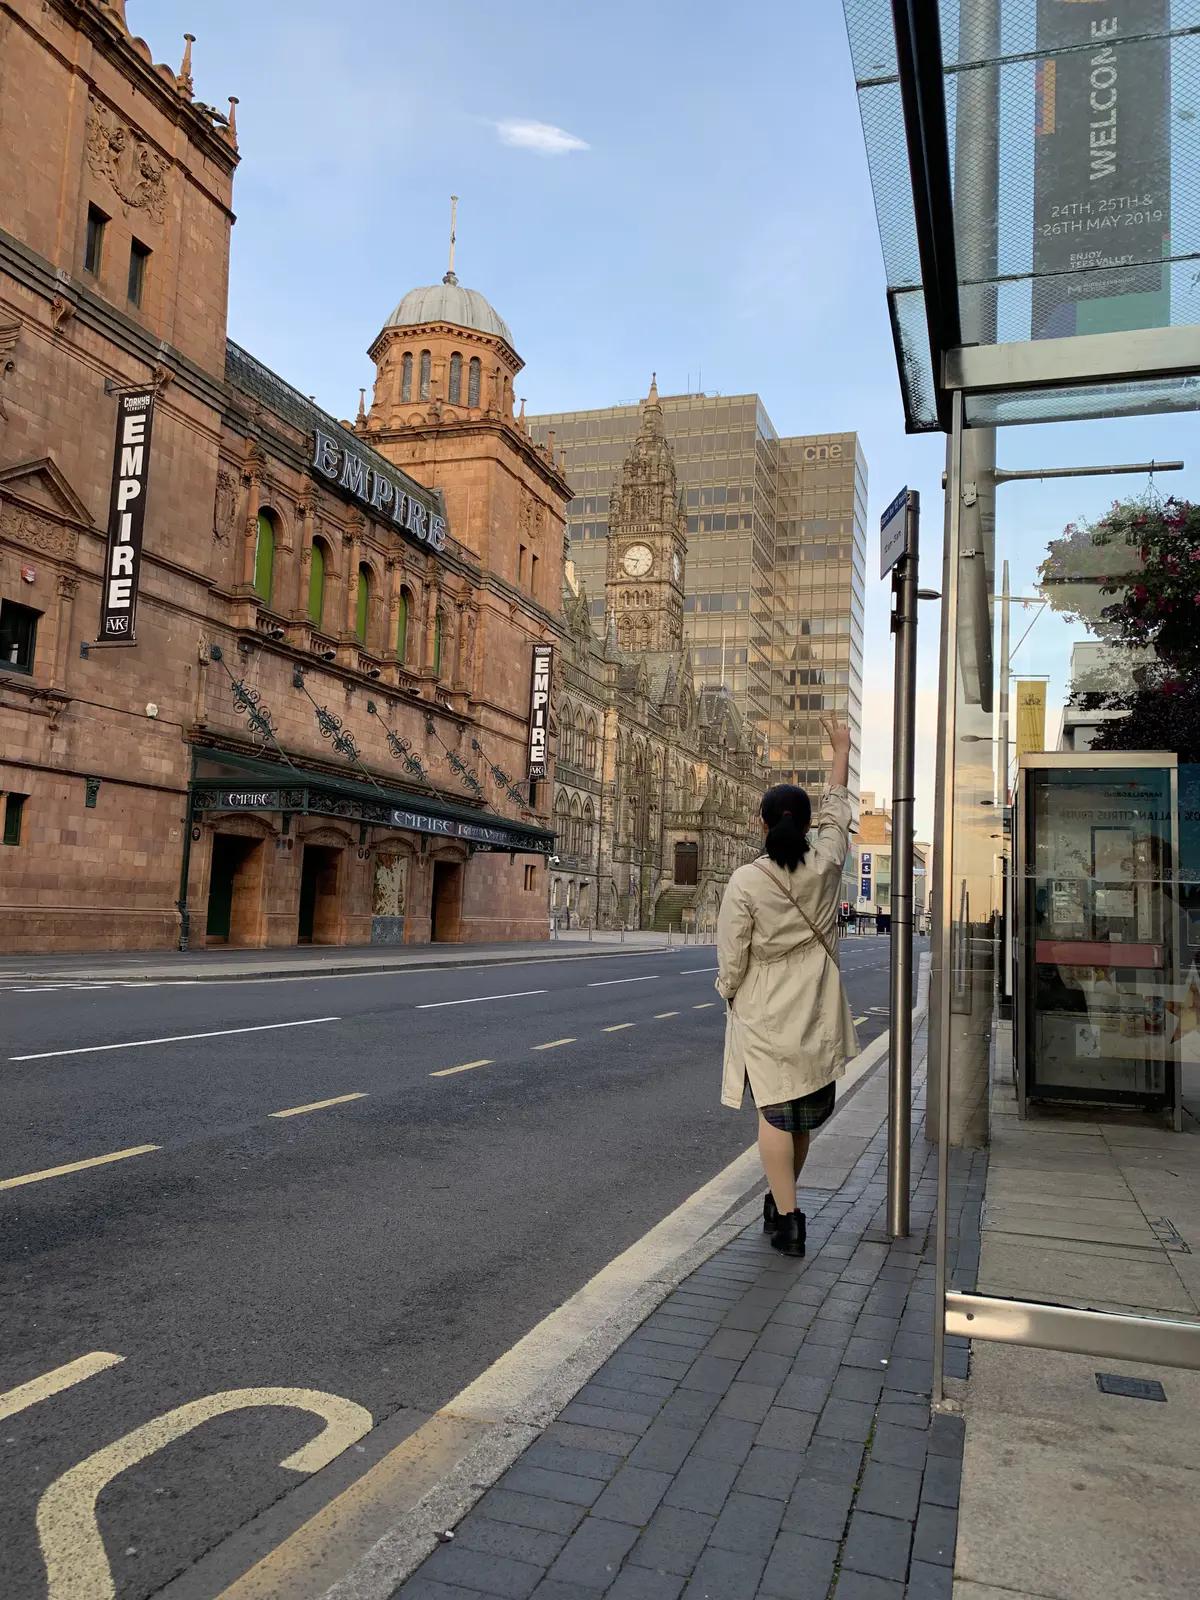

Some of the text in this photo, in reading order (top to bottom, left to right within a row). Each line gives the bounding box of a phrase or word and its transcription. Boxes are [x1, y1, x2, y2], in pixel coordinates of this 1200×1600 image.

[1051, 193, 1153, 218] 24TH, 25TH &
[1042, 210, 1163, 237] 26TH MAY 2019
[314, 428, 446, 552] EMPIRE
[108, 414, 146, 608] EMPIRE
[109, 618, 125, 631] VK
[531, 657, 550, 762] EMPIRE
[229, 793, 269, 806] EMPIRE
[394, 811, 452, 833] EMPIRE
